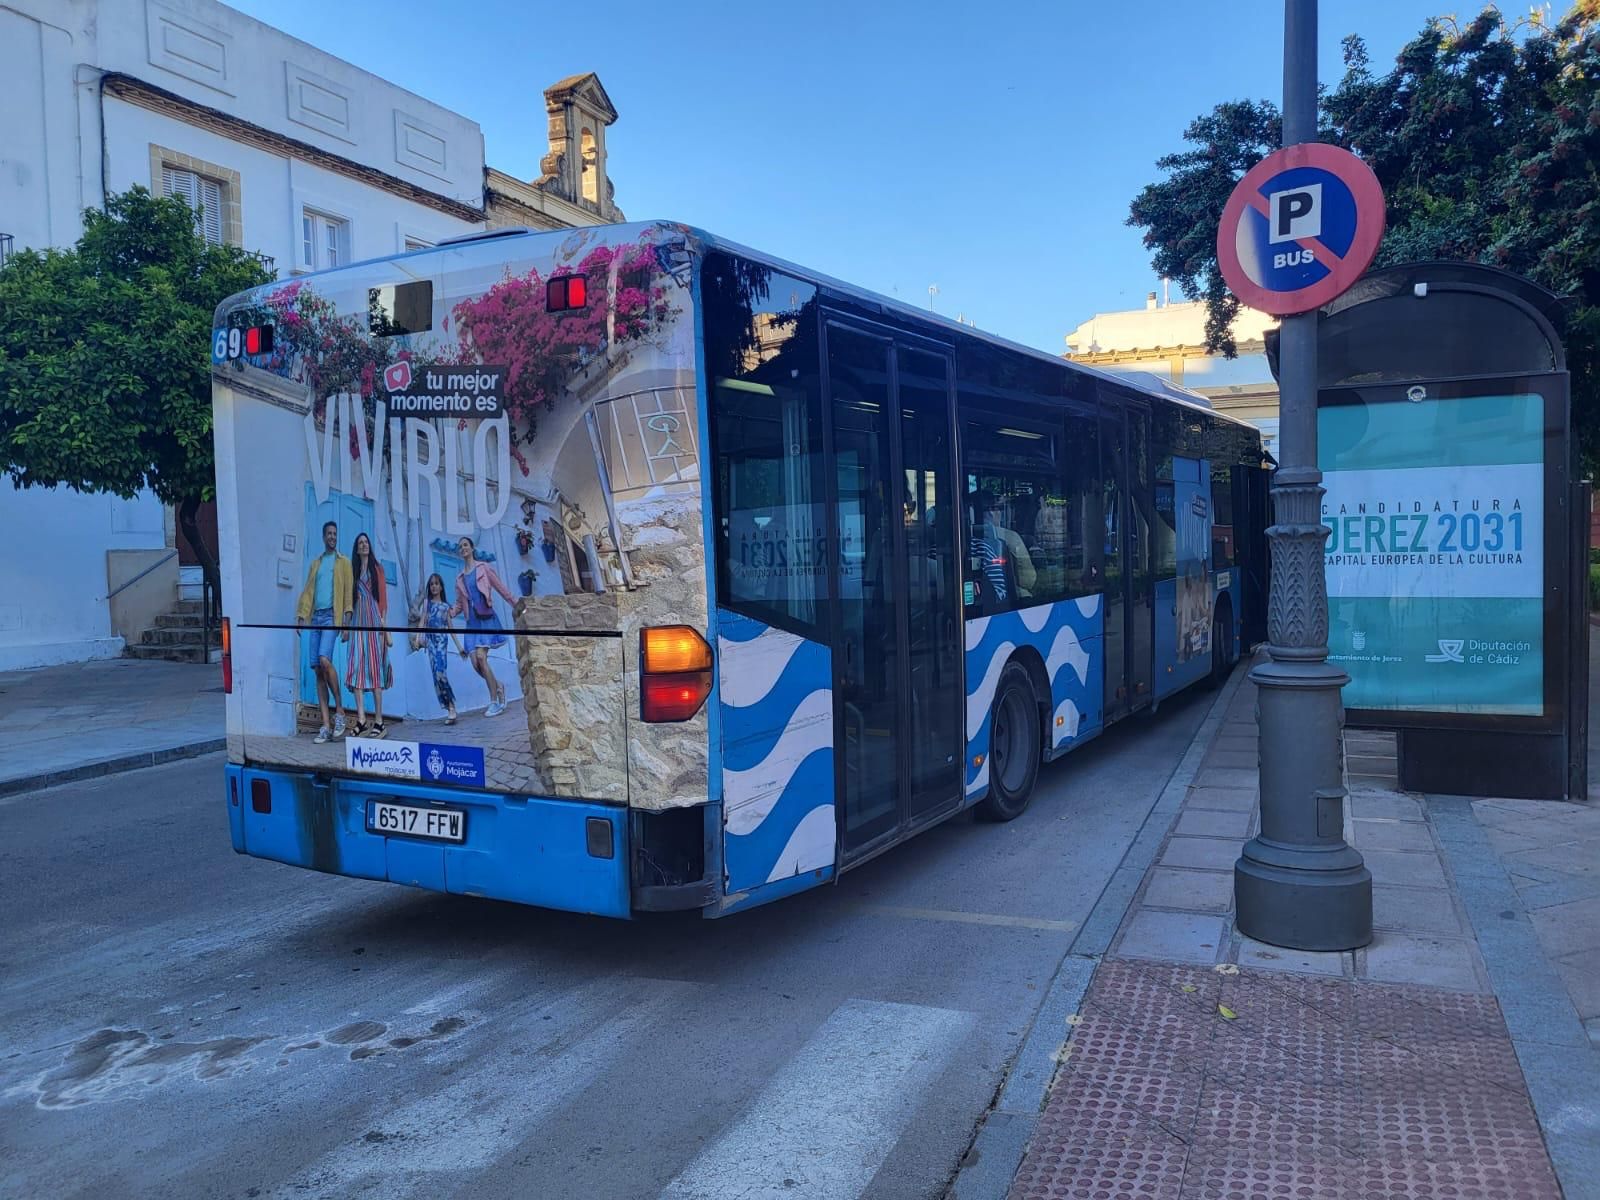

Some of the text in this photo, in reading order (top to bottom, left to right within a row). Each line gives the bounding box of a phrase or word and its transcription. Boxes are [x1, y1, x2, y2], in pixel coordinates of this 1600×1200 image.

[1278, 192, 1314, 236] P
[1273, 249, 1314, 269] BUS
[215, 328, 241, 359] 69
[426, 369, 499, 395] tu mejor
[391, 392, 497, 412] momento es
[304, 393, 511, 535] VIVIRLO
[1321, 498, 1521, 515] CANDIDATURA
[1322, 512, 1522, 553] JEREZ 2031
[1371, 554, 1424, 566] EUROPEA
[1429, 554, 1444, 565] DE
[1449, 554, 1464, 565] LA
[1469, 553, 1523, 565] CULTURA
[1469, 639, 1531, 653] Diputación
[1469, 653, 1520, 665] de Cádiz
[352, 745, 399, 768] Mojácar
[446, 767, 477, 778] Mojácar
[380, 807, 460, 837] 6517 FFW
